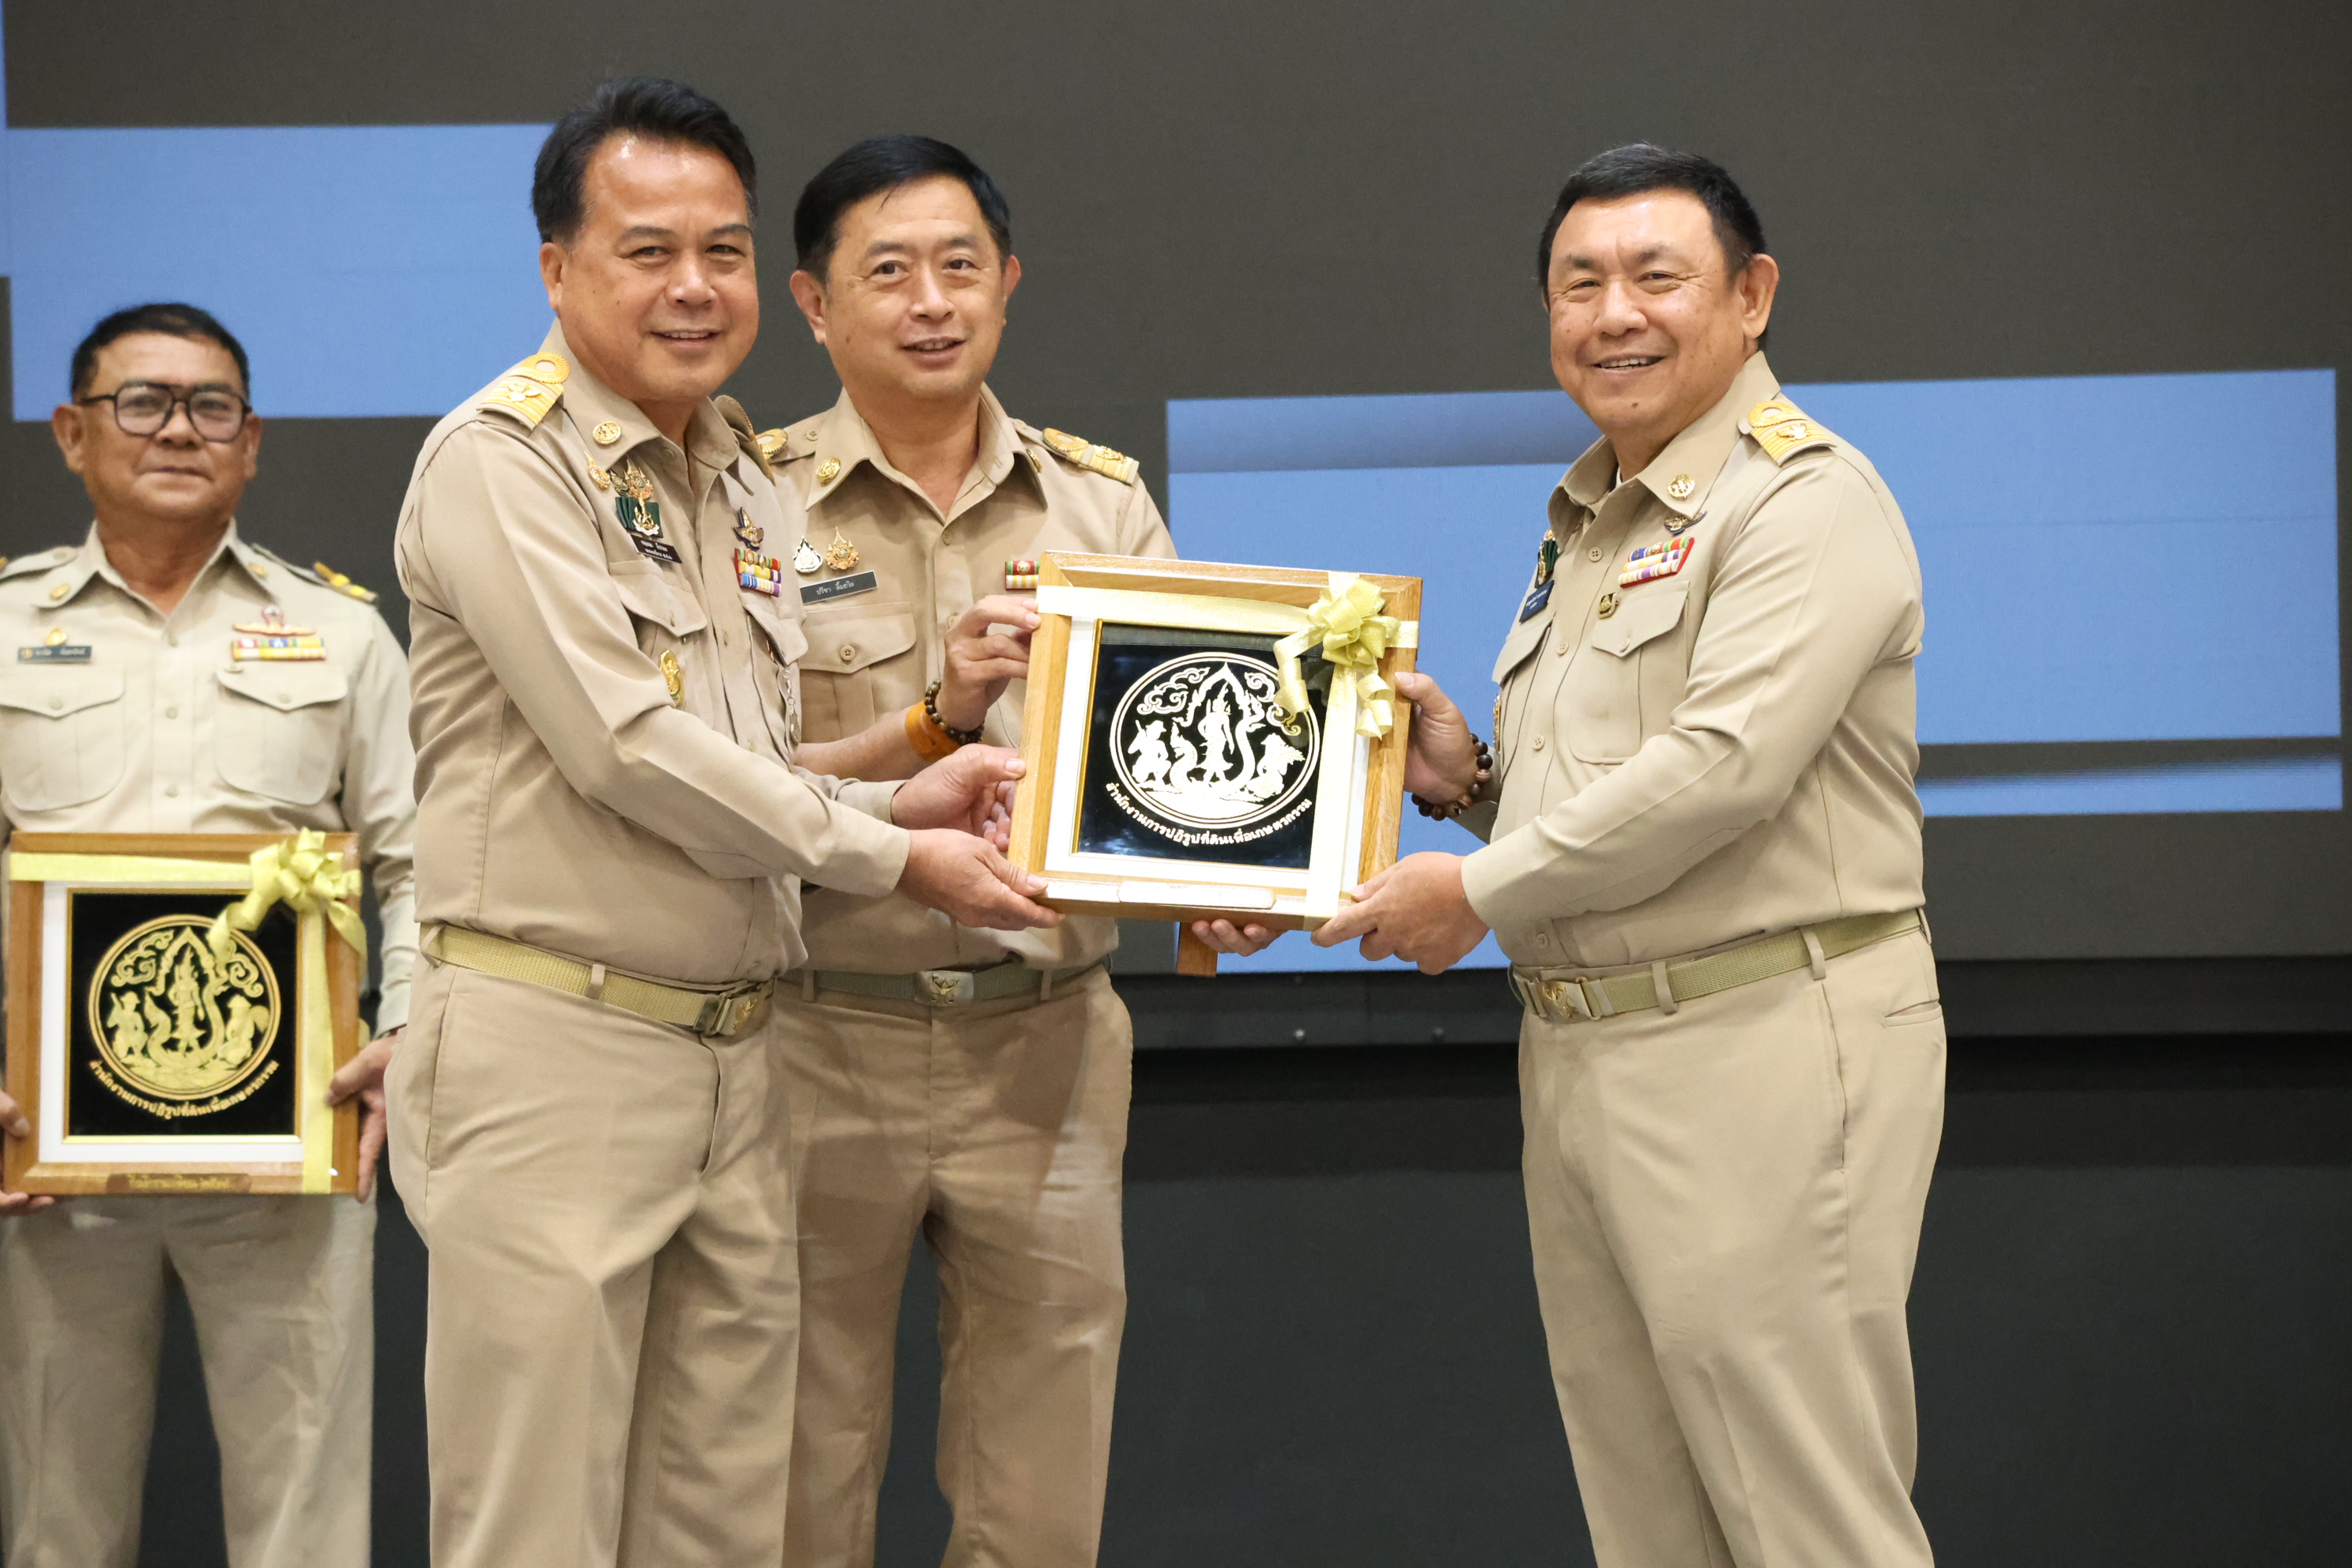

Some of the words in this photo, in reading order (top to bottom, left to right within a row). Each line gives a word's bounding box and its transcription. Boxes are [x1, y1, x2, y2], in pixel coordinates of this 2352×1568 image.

[1105, 782, 1313, 846] สำนักงานการปฏิรูปที่ดินเพื่อเกษตรกรรม
